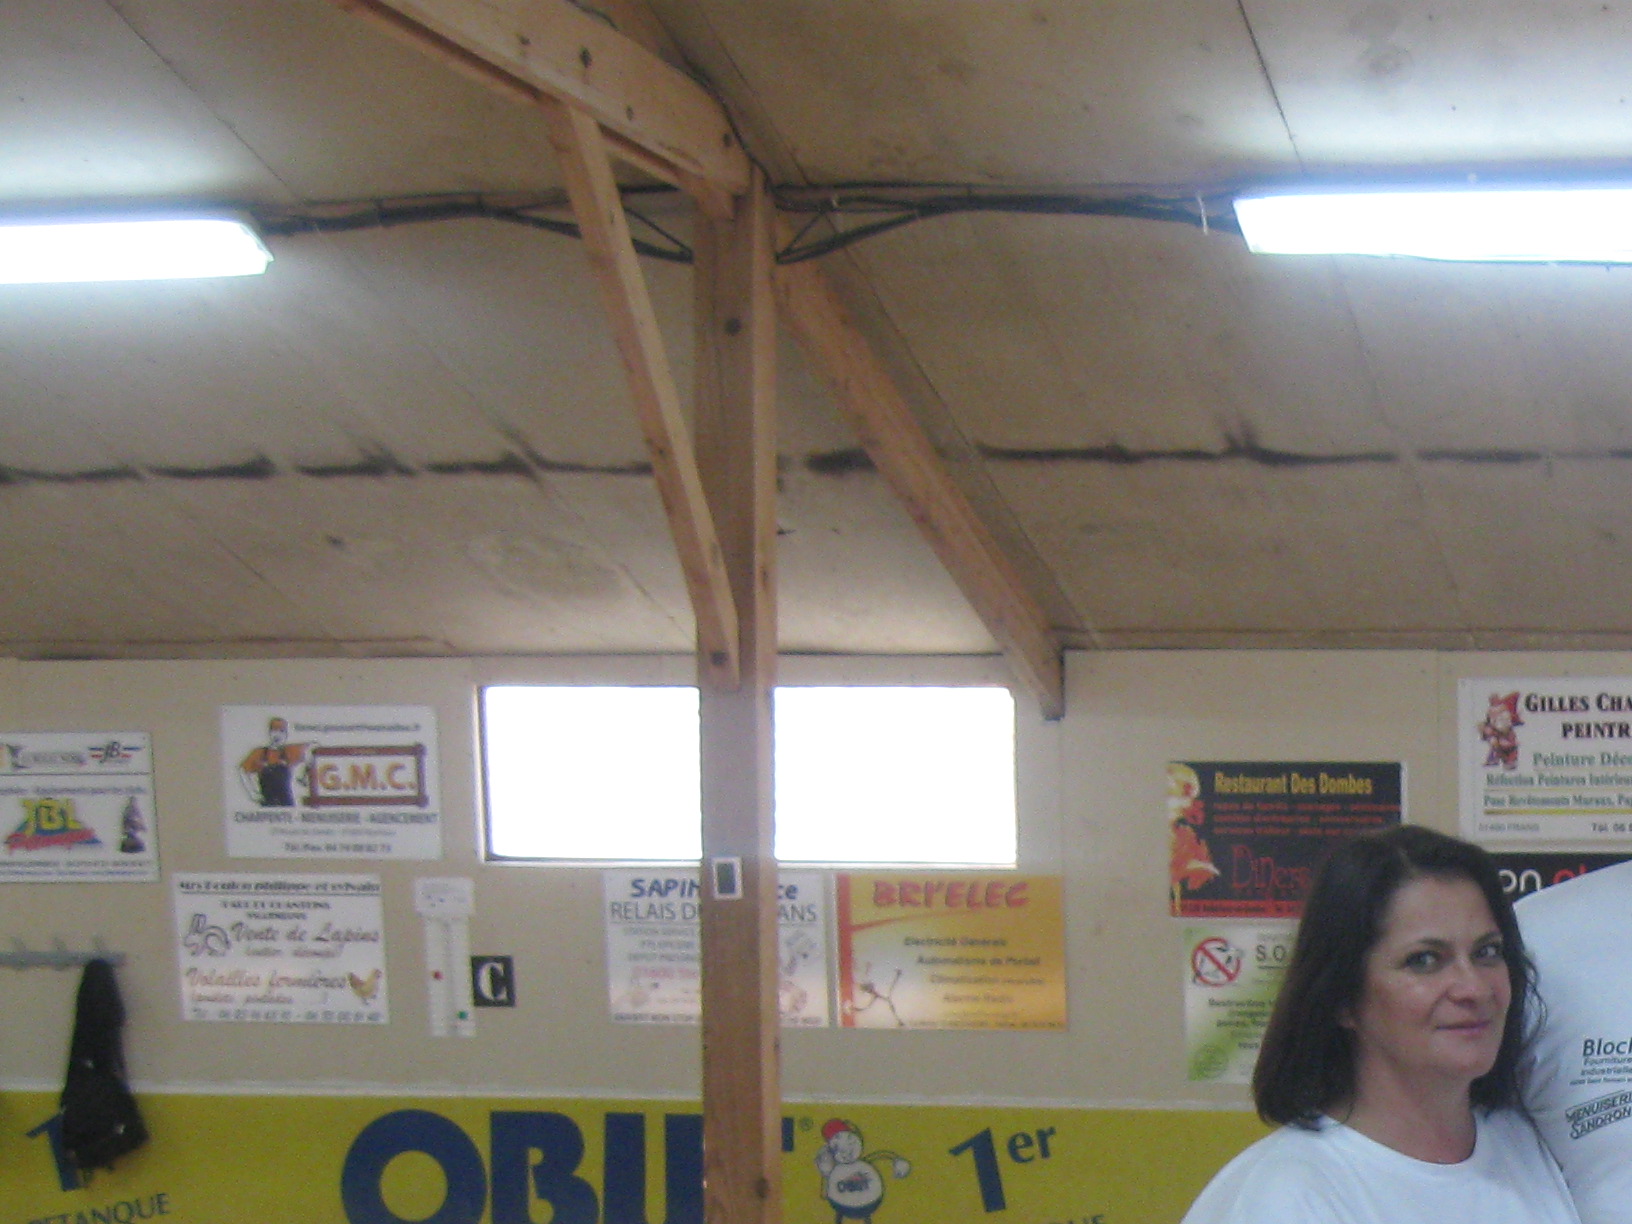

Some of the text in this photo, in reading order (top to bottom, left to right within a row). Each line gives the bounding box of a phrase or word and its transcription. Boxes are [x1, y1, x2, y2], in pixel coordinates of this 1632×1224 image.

[1525, 693, 1590, 712] GILLES
[1533, 752, 1596, 767] Peinture
[318, 763, 417, 791] G.M.C.
[1214, 772, 1373, 795] Restaurant Des Dombes
[610, 901, 677, 921] RELAIS
[682, 902, 701, 921] D
[477, 961, 508, 1001] C
[948, 1125, 1057, 1214] 1er
